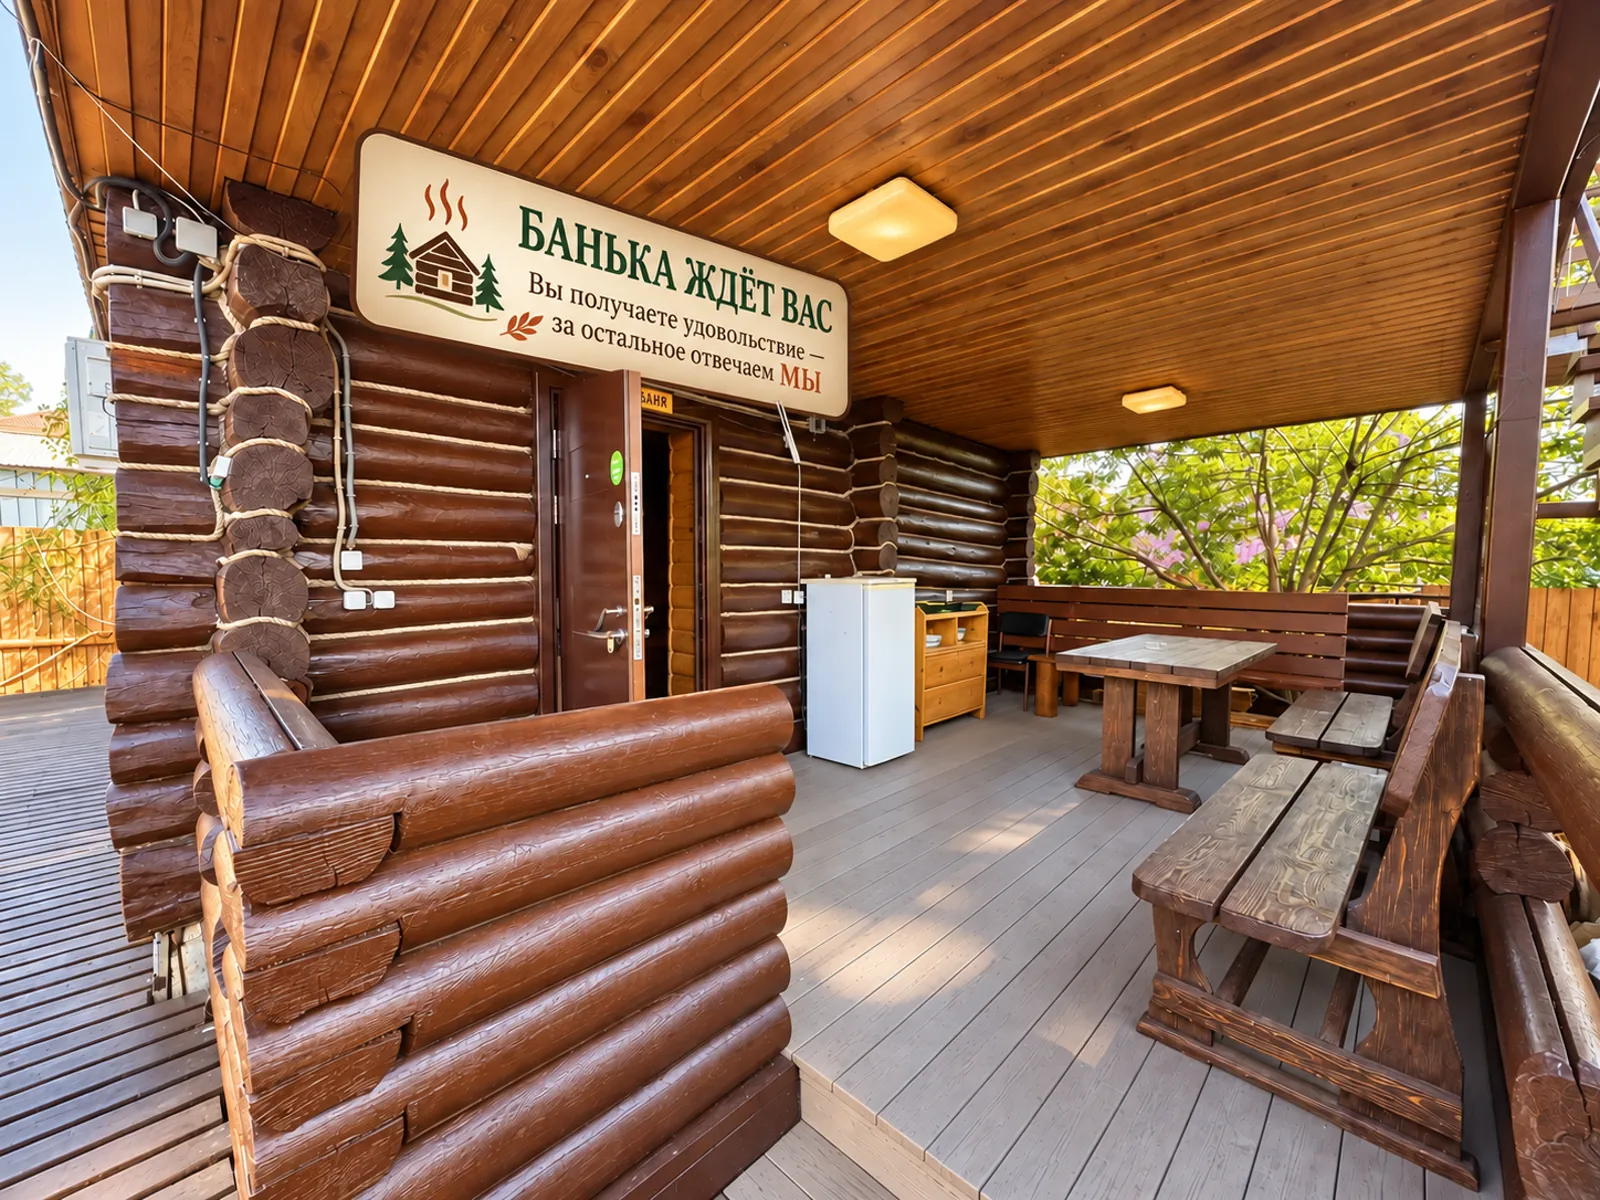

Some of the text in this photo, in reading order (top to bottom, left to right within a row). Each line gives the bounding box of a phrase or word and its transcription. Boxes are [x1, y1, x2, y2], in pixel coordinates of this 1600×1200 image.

[518, 205, 833, 334] БАНЬКА ЖДЁТ ВАС
[528, 271, 563, 301] Вы
[570, 288, 678, 329] получаете
[683, 316, 805, 361] удовольствие
[551, 316, 822, 394] за остальное отвечаем МЫ
